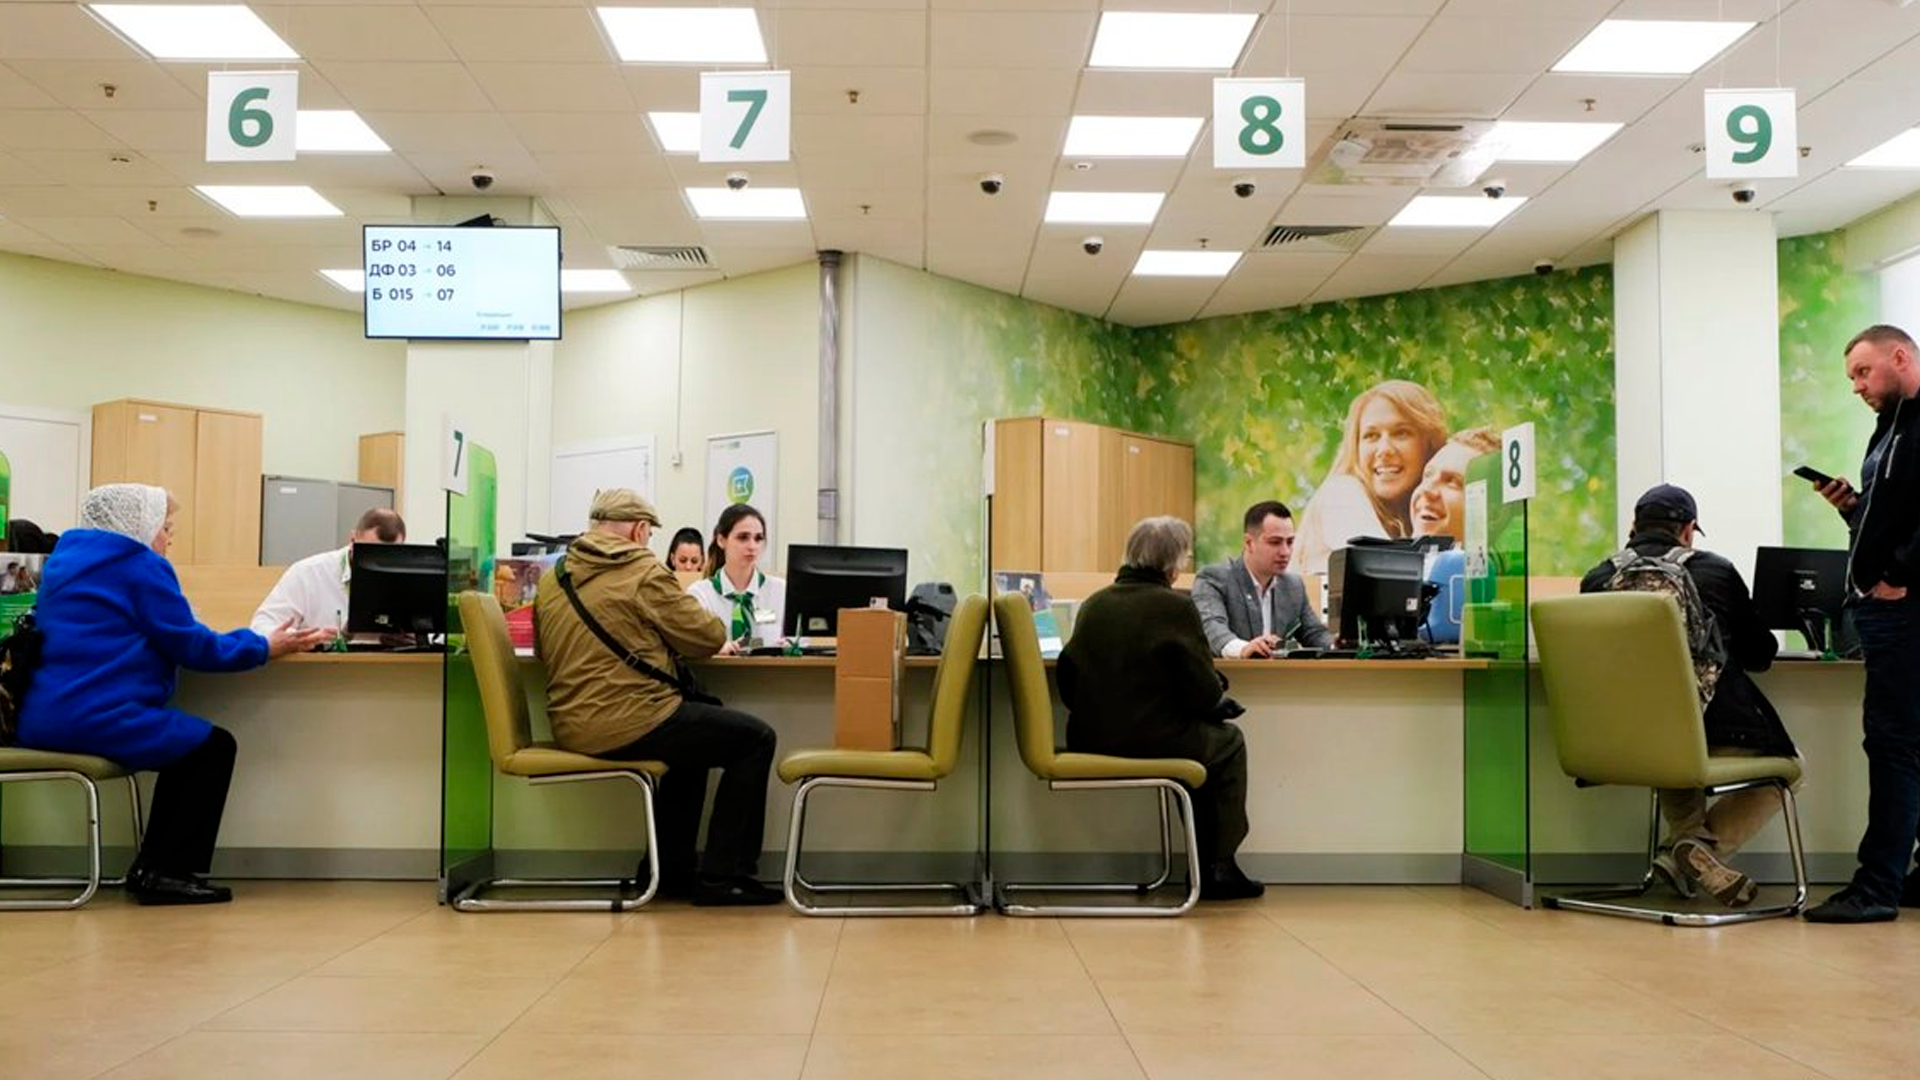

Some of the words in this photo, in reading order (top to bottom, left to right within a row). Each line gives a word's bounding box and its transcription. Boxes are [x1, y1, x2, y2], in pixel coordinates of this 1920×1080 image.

[228, 87, 274, 148] 6
[726, 89, 768, 150] 7
[1238, 95, 1284, 156] 8
[1726, 104, 1773, 164] 9
[371, 239, 392, 252] БР
[397, 239, 417, 252] 04
[437, 239, 452, 252] 14
[369, 264, 395, 277] ДФ
[398, 264, 417, 277] 03
[436, 264, 456, 277] 06
[372, 288, 383, 301] Б
[389, 288, 414, 301] 015
[436, 288, 455, 301] 07
[453, 430, 463, 477] 7
[1509, 439, 1521, 488] 8
